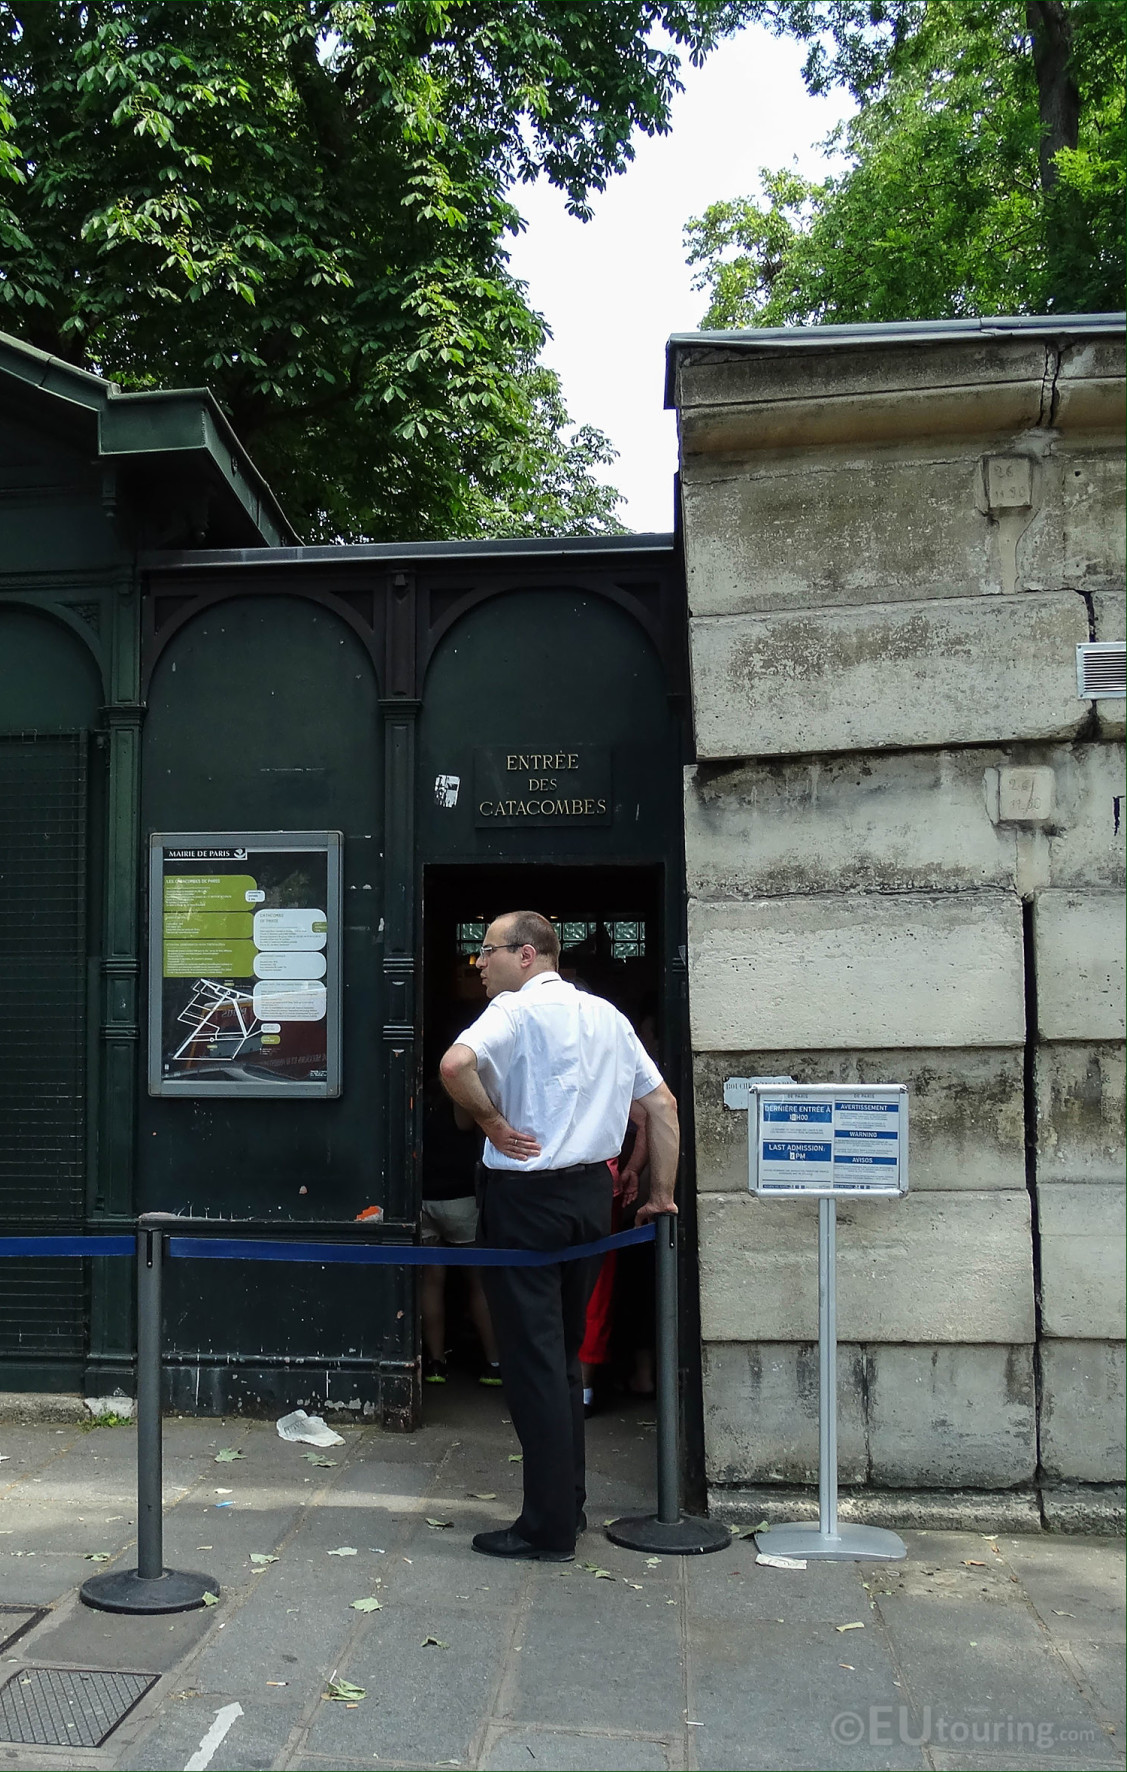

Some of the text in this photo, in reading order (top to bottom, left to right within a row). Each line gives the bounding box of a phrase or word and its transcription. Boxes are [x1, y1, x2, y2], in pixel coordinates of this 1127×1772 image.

[506, 750, 579, 771] ENTRÉE
[528, 778, 558, 792] DES
[479, 799, 607, 816] CATACOMBES
[799, 1105, 825, 1113] ENTRÉE
[825, 1105, 832, 1113] À
